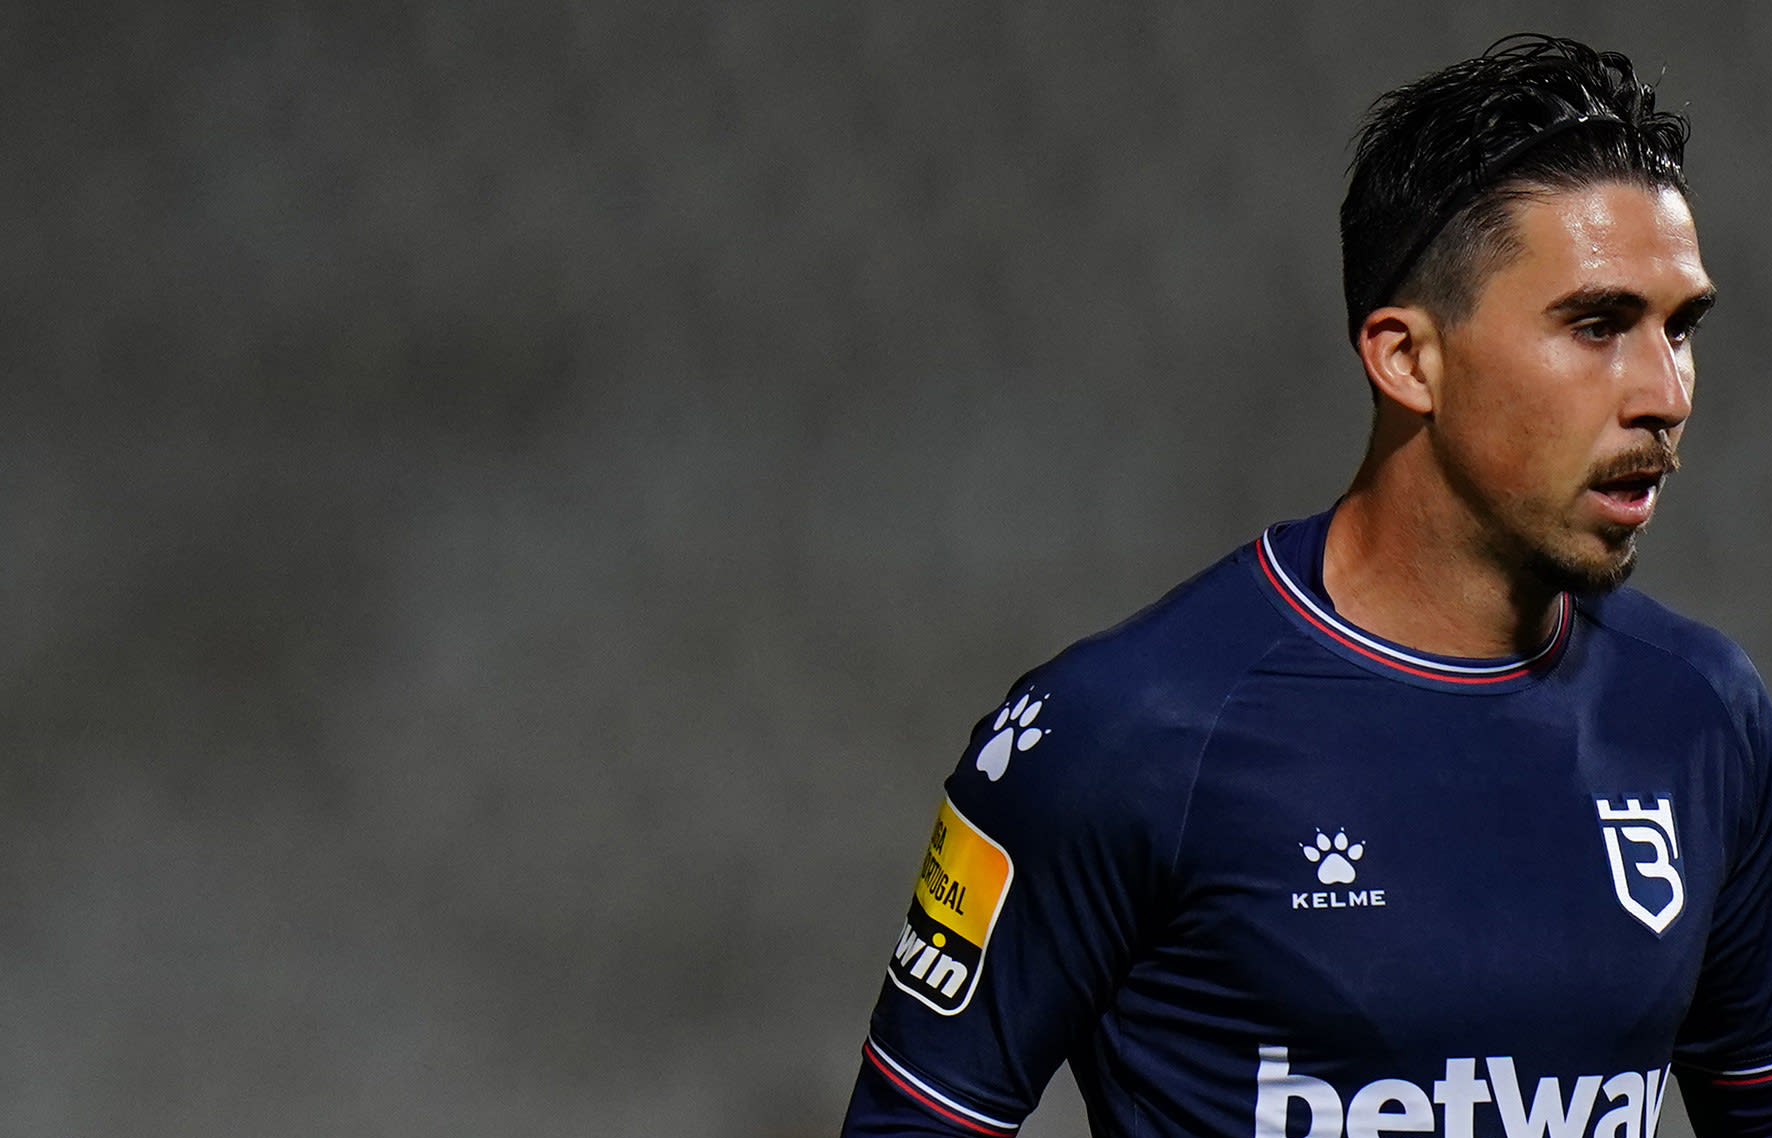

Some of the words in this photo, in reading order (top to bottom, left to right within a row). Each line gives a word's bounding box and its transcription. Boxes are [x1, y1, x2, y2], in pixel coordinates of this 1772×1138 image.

[921, 850, 966, 916] ORTUGAL
[1291, 888, 1387, 910] KELME
[895, 922, 968, 999] win
